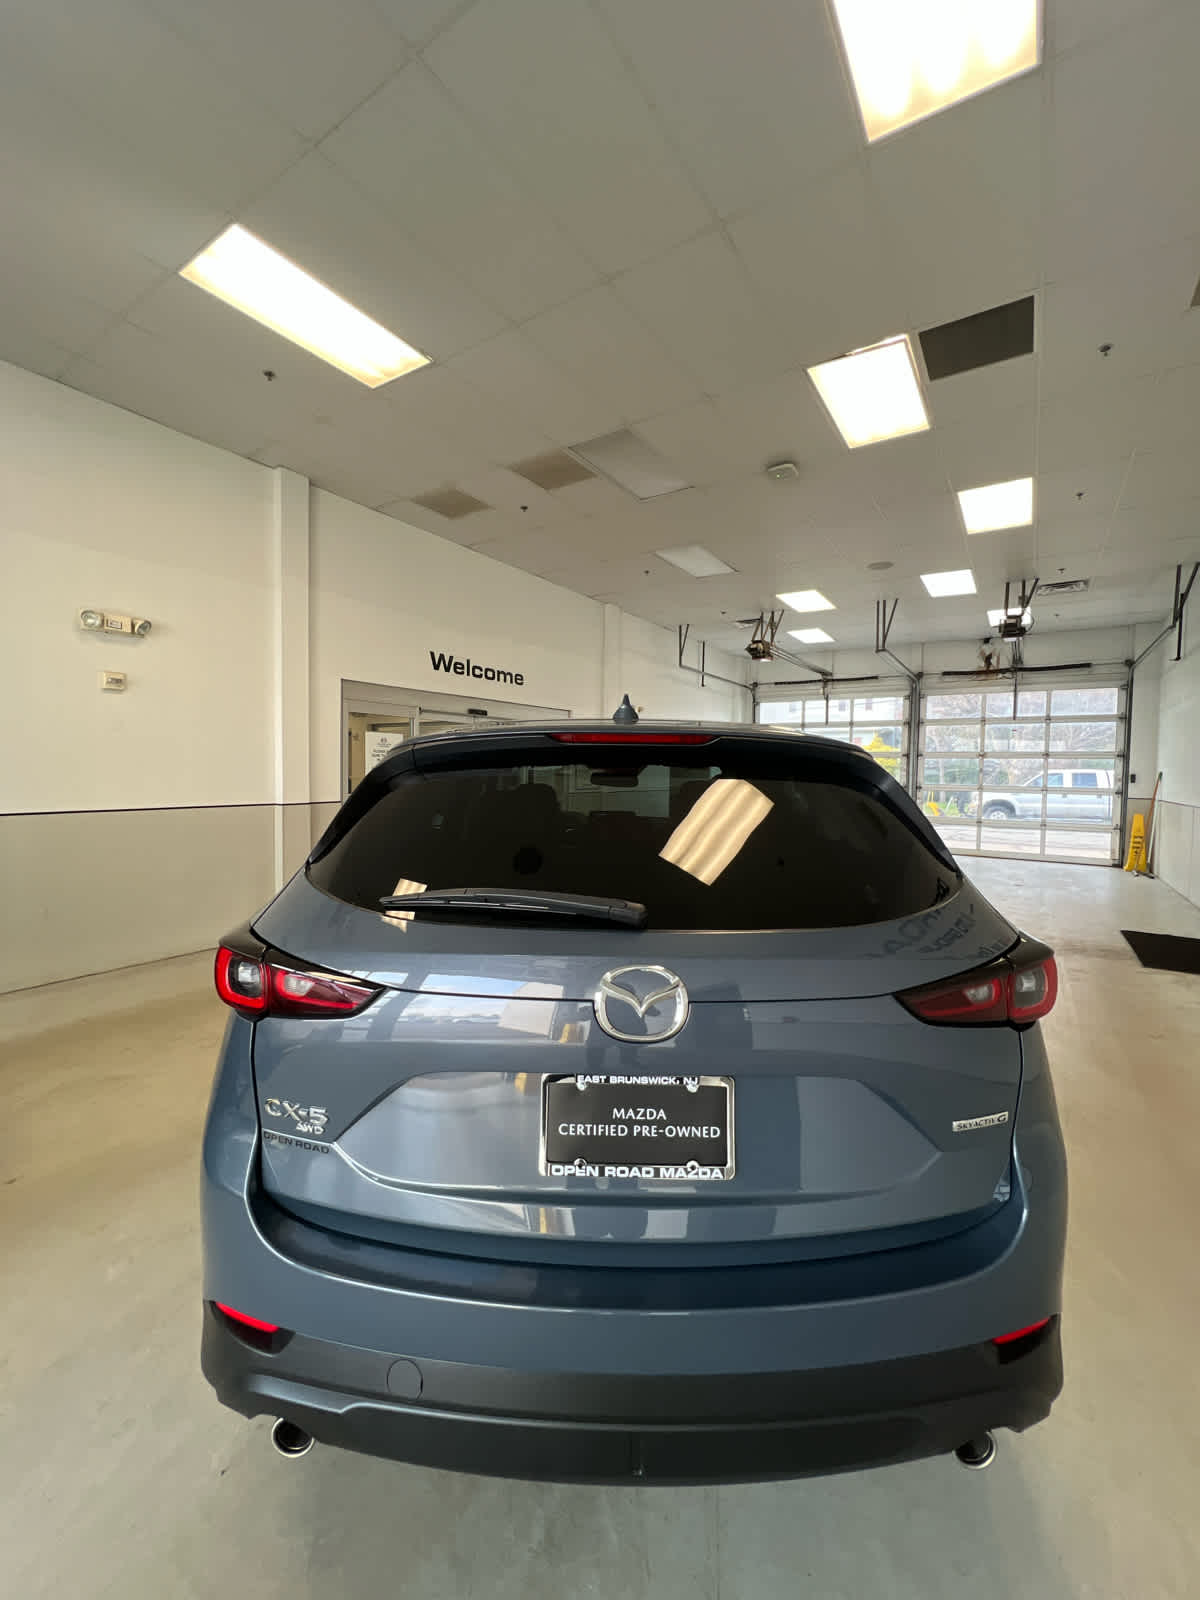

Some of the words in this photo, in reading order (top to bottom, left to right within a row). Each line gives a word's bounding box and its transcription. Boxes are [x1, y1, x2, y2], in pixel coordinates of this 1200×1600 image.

[430, 651, 524, 686] Welcome
[577, 1075, 607, 1084] EAST
[683, 1077, 699, 1086] NJ
[264, 1098, 328, 1126] CX-5
[612, 1108, 667, 1121] MAZDA
[558, 1123, 628, 1137] CERTIFIED
[633, 1124, 721, 1138] PRE-OWNED
[263, 1131, 293, 1145] OPEN
[295, 1141, 330, 1154] ROAD
[551, 1164, 599, 1177] OPEN
[604, 1166, 654, 1178] ROAD
